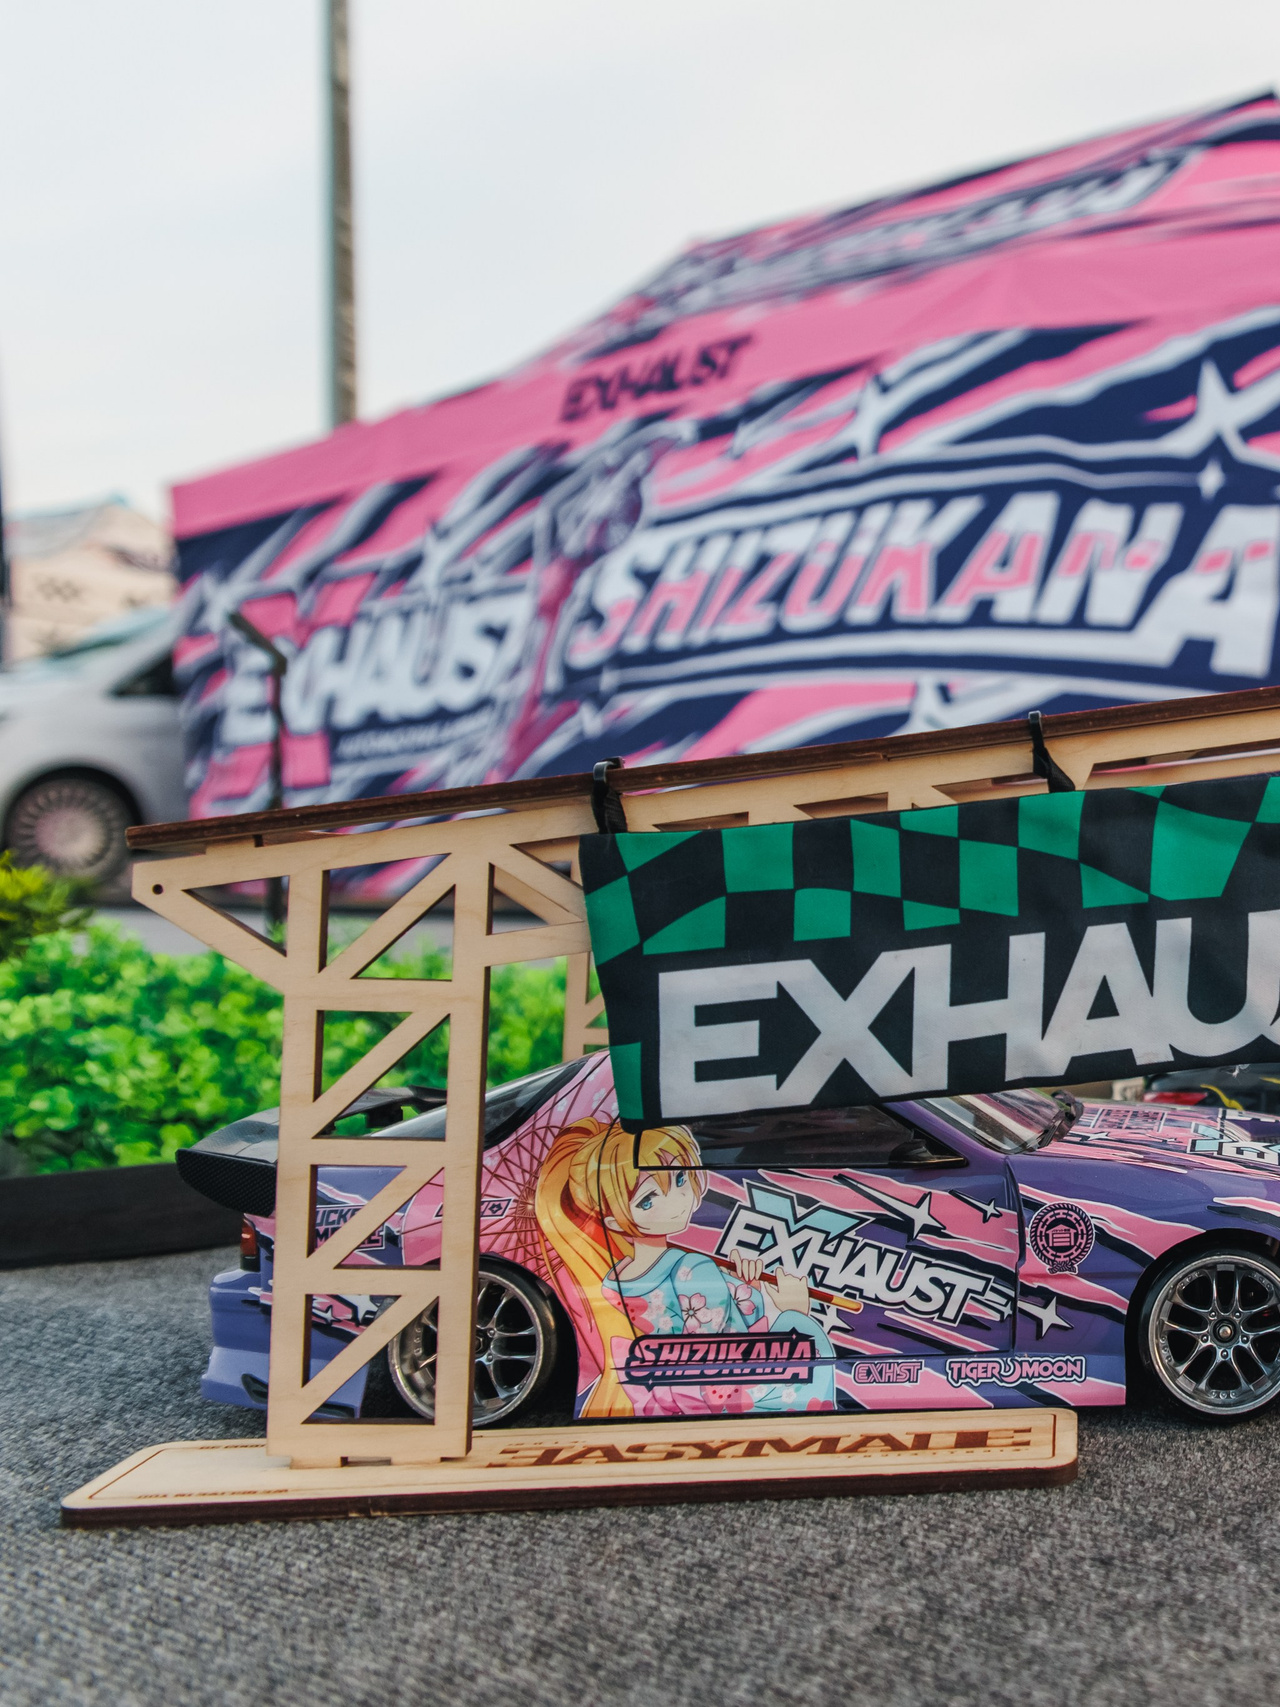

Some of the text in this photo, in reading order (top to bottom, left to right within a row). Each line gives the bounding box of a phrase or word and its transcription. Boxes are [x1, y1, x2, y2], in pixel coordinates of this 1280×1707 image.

[718, 1204, 989, 1324] EXHAUST
[632, 1336, 813, 1382] SHIZUKANA
[854, 1362, 922, 1383] EXHST
[950, 1359, 1083, 1383] TIGER MOON
